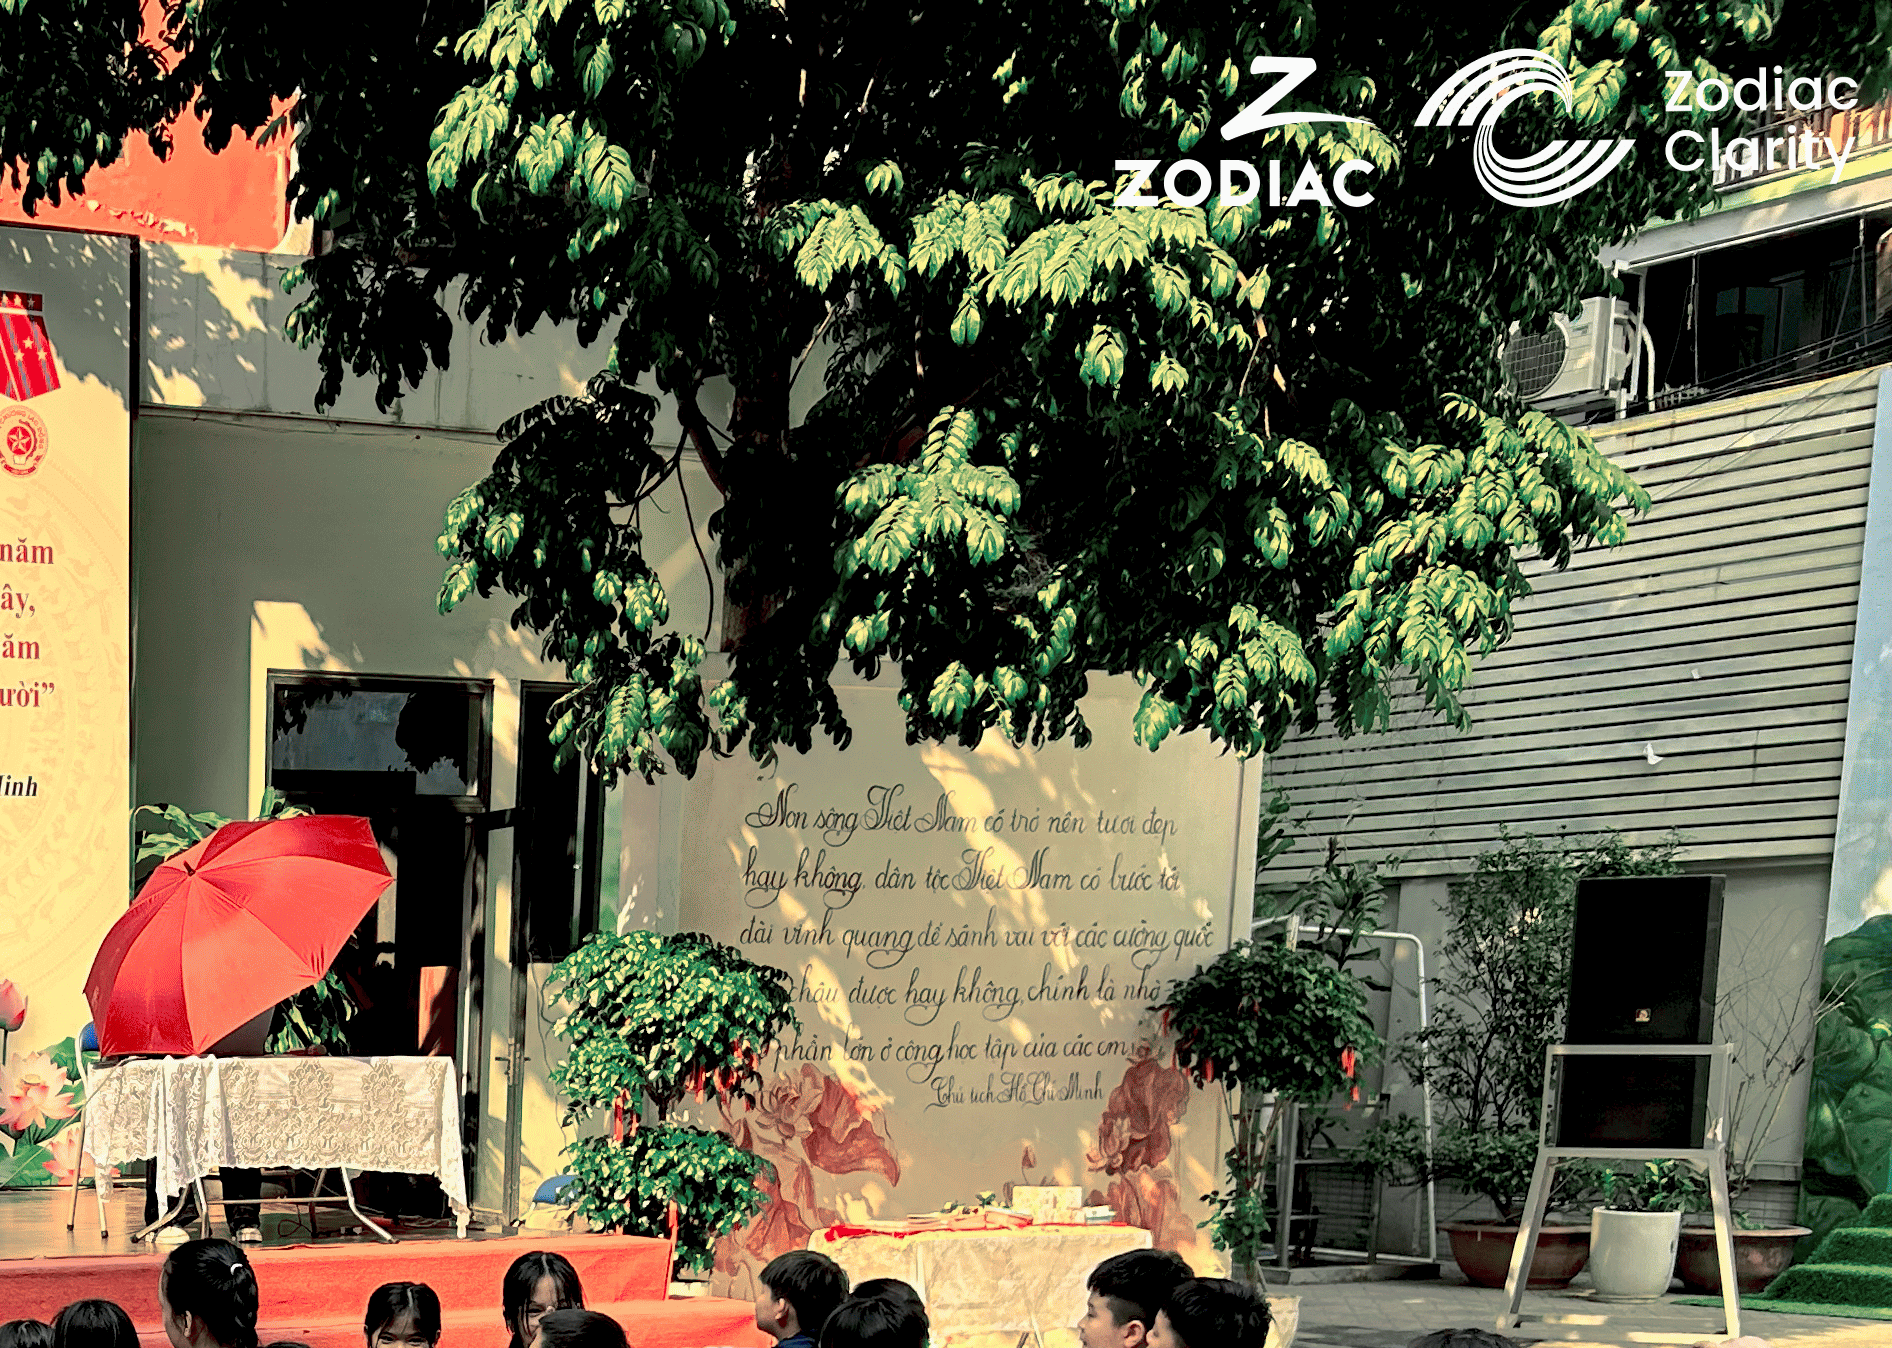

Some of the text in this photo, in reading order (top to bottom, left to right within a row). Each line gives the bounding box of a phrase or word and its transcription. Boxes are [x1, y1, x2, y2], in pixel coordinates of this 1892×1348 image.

[0, 536, 54, 565] năm
[1047, 811, 1087, 834] nên
[875, 858, 916, 890] dân
[842, 929, 914, 969] quang
[896, 1039, 944, 1084] công
